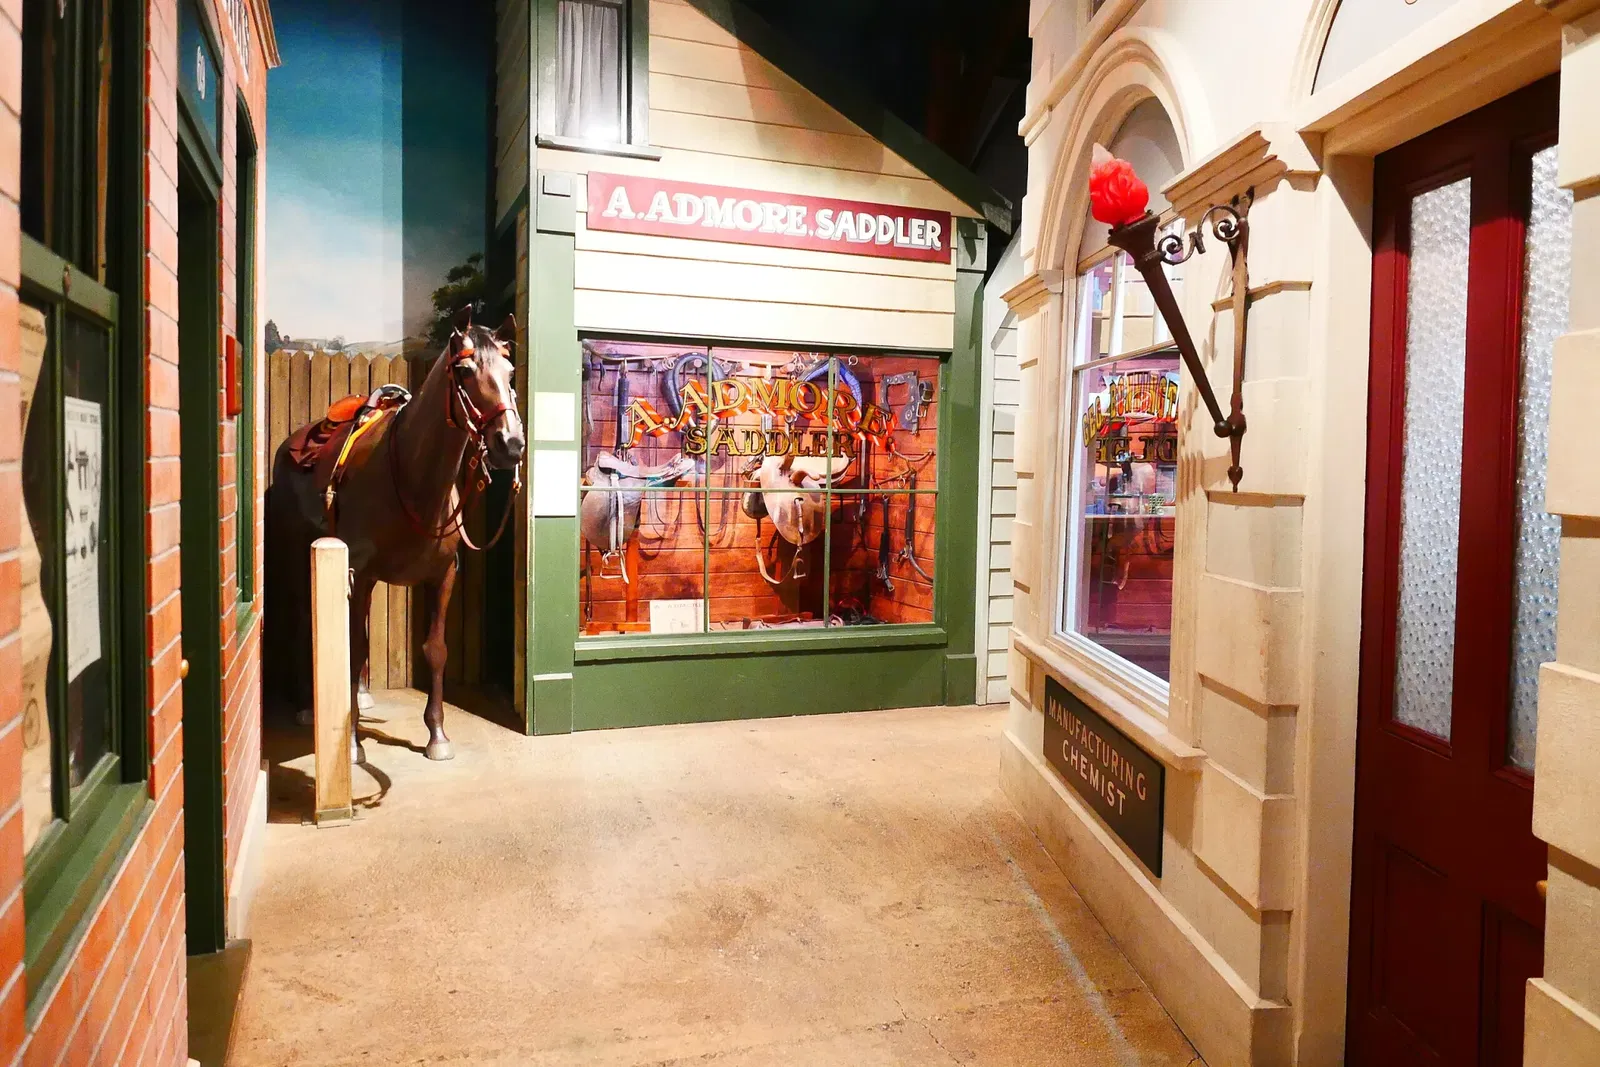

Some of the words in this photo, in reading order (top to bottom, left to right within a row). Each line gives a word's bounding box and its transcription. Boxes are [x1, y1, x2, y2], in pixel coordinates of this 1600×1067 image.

[685, 427, 857, 458] SADDLER
[1048, 695, 1147, 801] MANUFACTURING
[1062, 739, 1126, 816] CHEMIST
